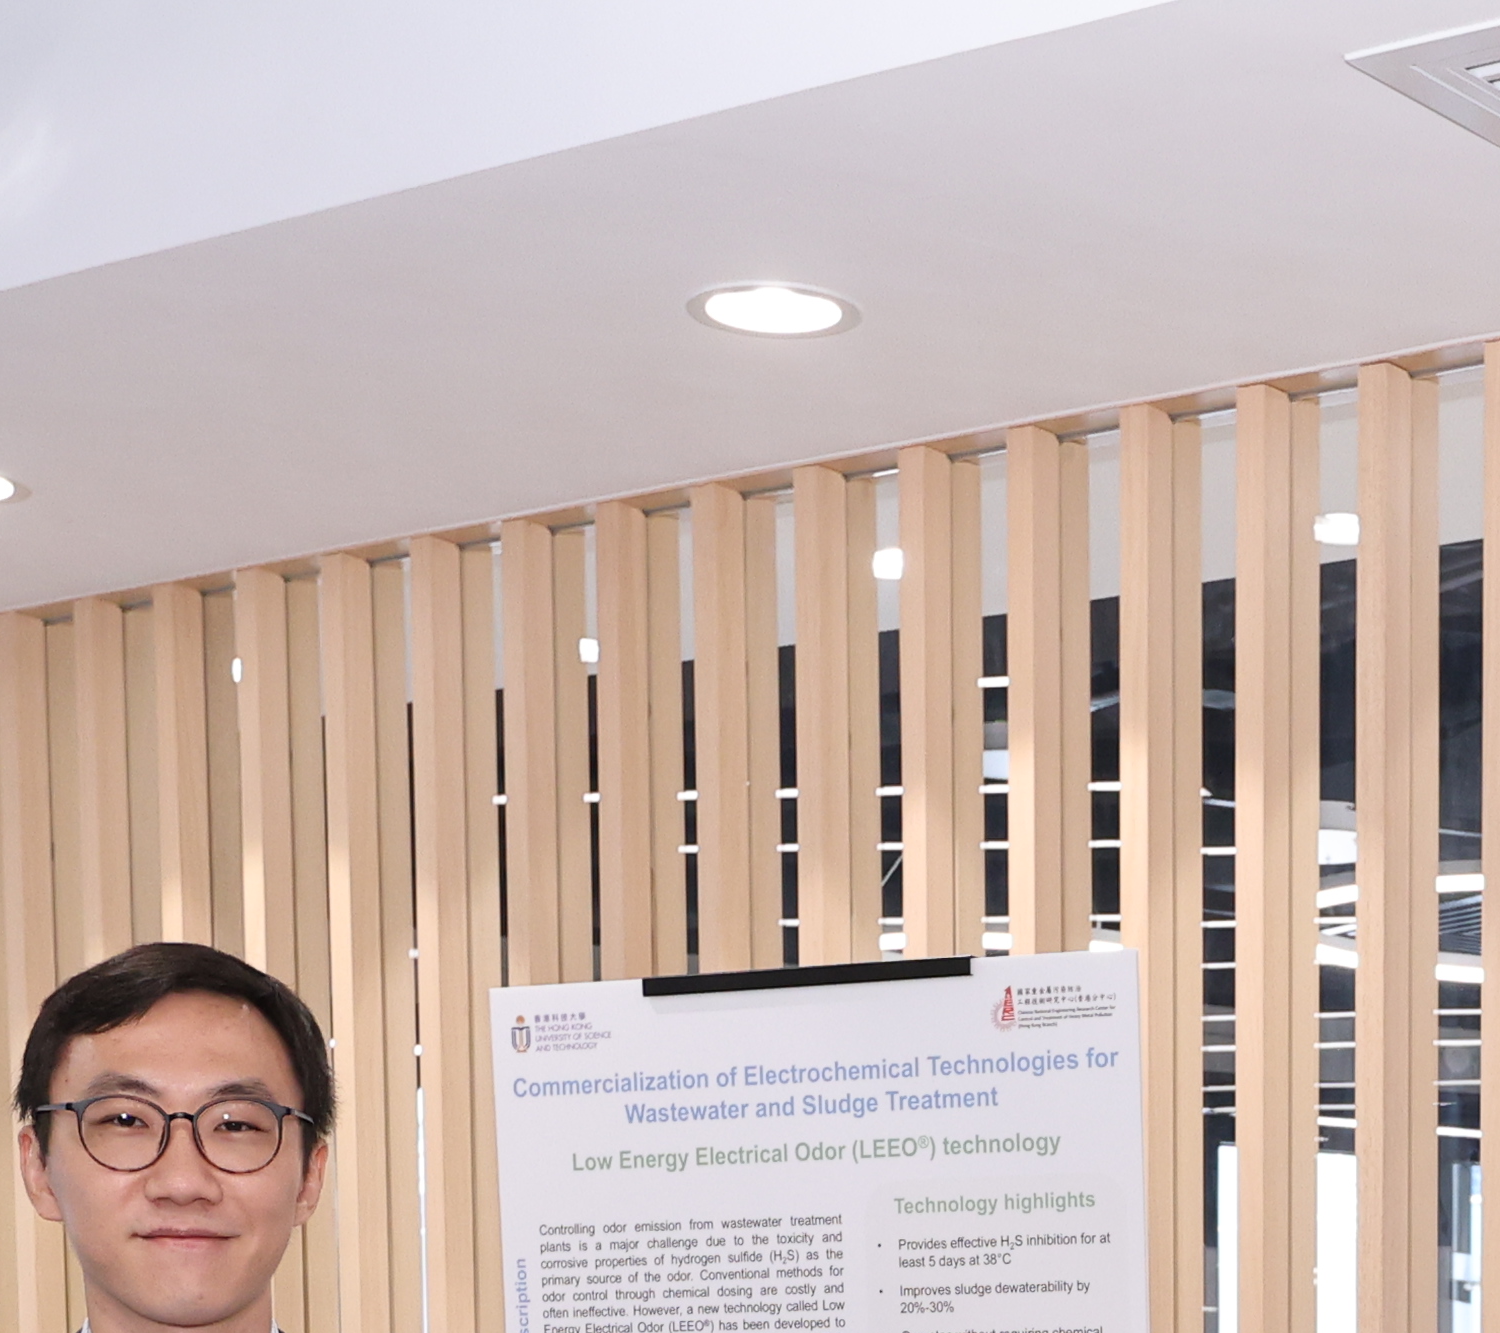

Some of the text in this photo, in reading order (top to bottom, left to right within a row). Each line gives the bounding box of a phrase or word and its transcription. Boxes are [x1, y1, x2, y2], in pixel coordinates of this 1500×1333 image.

[535, 1031, 611, 1042] UNIVERSITY OF SCIENCE
[548, 1024, 569, 1032] HONG
[536, 1042, 597, 1052] AND TECHNOLOGY
[513, 1048, 1118, 1098] Commercialization of Electrochemical Technologies for
[625, 1087, 998, 1123] Wastewater and Sludge Treatment
[572, 1133, 1061, 1172] Low Energy Electrical Odor (LEEO®) technology
[894, 1191, 1095, 1215] Technology highlights
